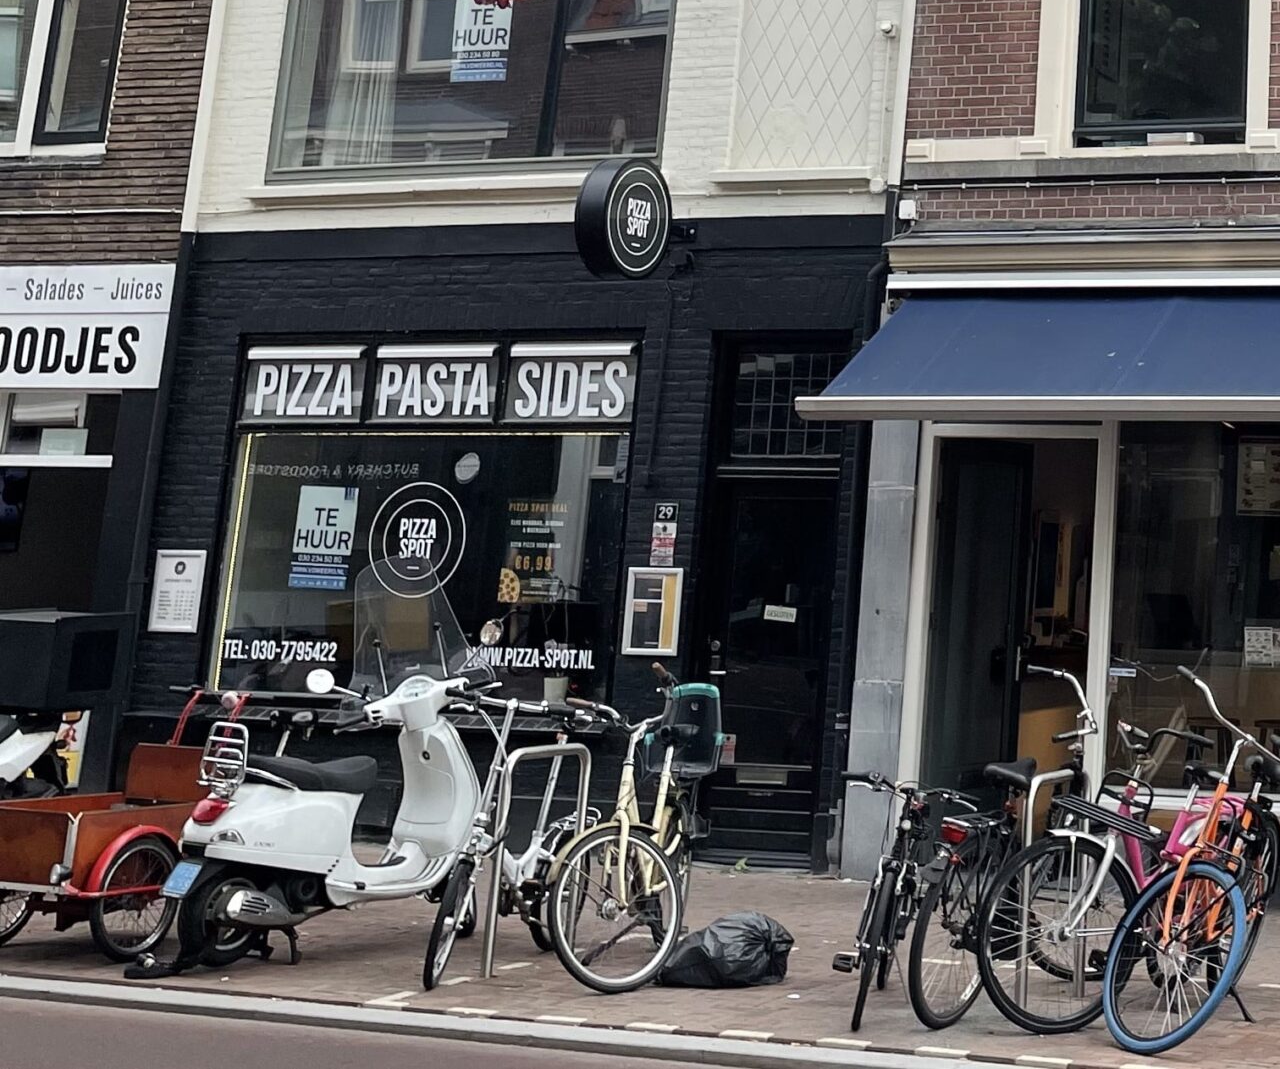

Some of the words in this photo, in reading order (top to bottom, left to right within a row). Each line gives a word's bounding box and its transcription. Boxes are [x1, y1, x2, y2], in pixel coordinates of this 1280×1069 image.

[471, 8, 495, 26] TE
[455, 28, 508, 47] HUUR
[627, 197, 651, 221] PIZZA
[626, 216, 650, 238] SPOT
[24, 278, 85, 301] Salades
[111, 277, 163, 300] Juices
[253, 363, 353, 416] PIZZA
[377, 362, 489, 417] PASTA
[514, 361, 628, 418] SIDES
[315, 507, 339, 527] TE
[658, 506, 674, 519] 29
[296, 528, 352, 550] HUUR
[399, 518, 437, 539] PIZZA
[398, 538, 435, 559] SPOT
[224, 639, 248, 659] TEL:
[251, 639, 338, 662] 030-7795422
[465, 646, 596, 670] WWW.PIZZA-SPOT.NL
